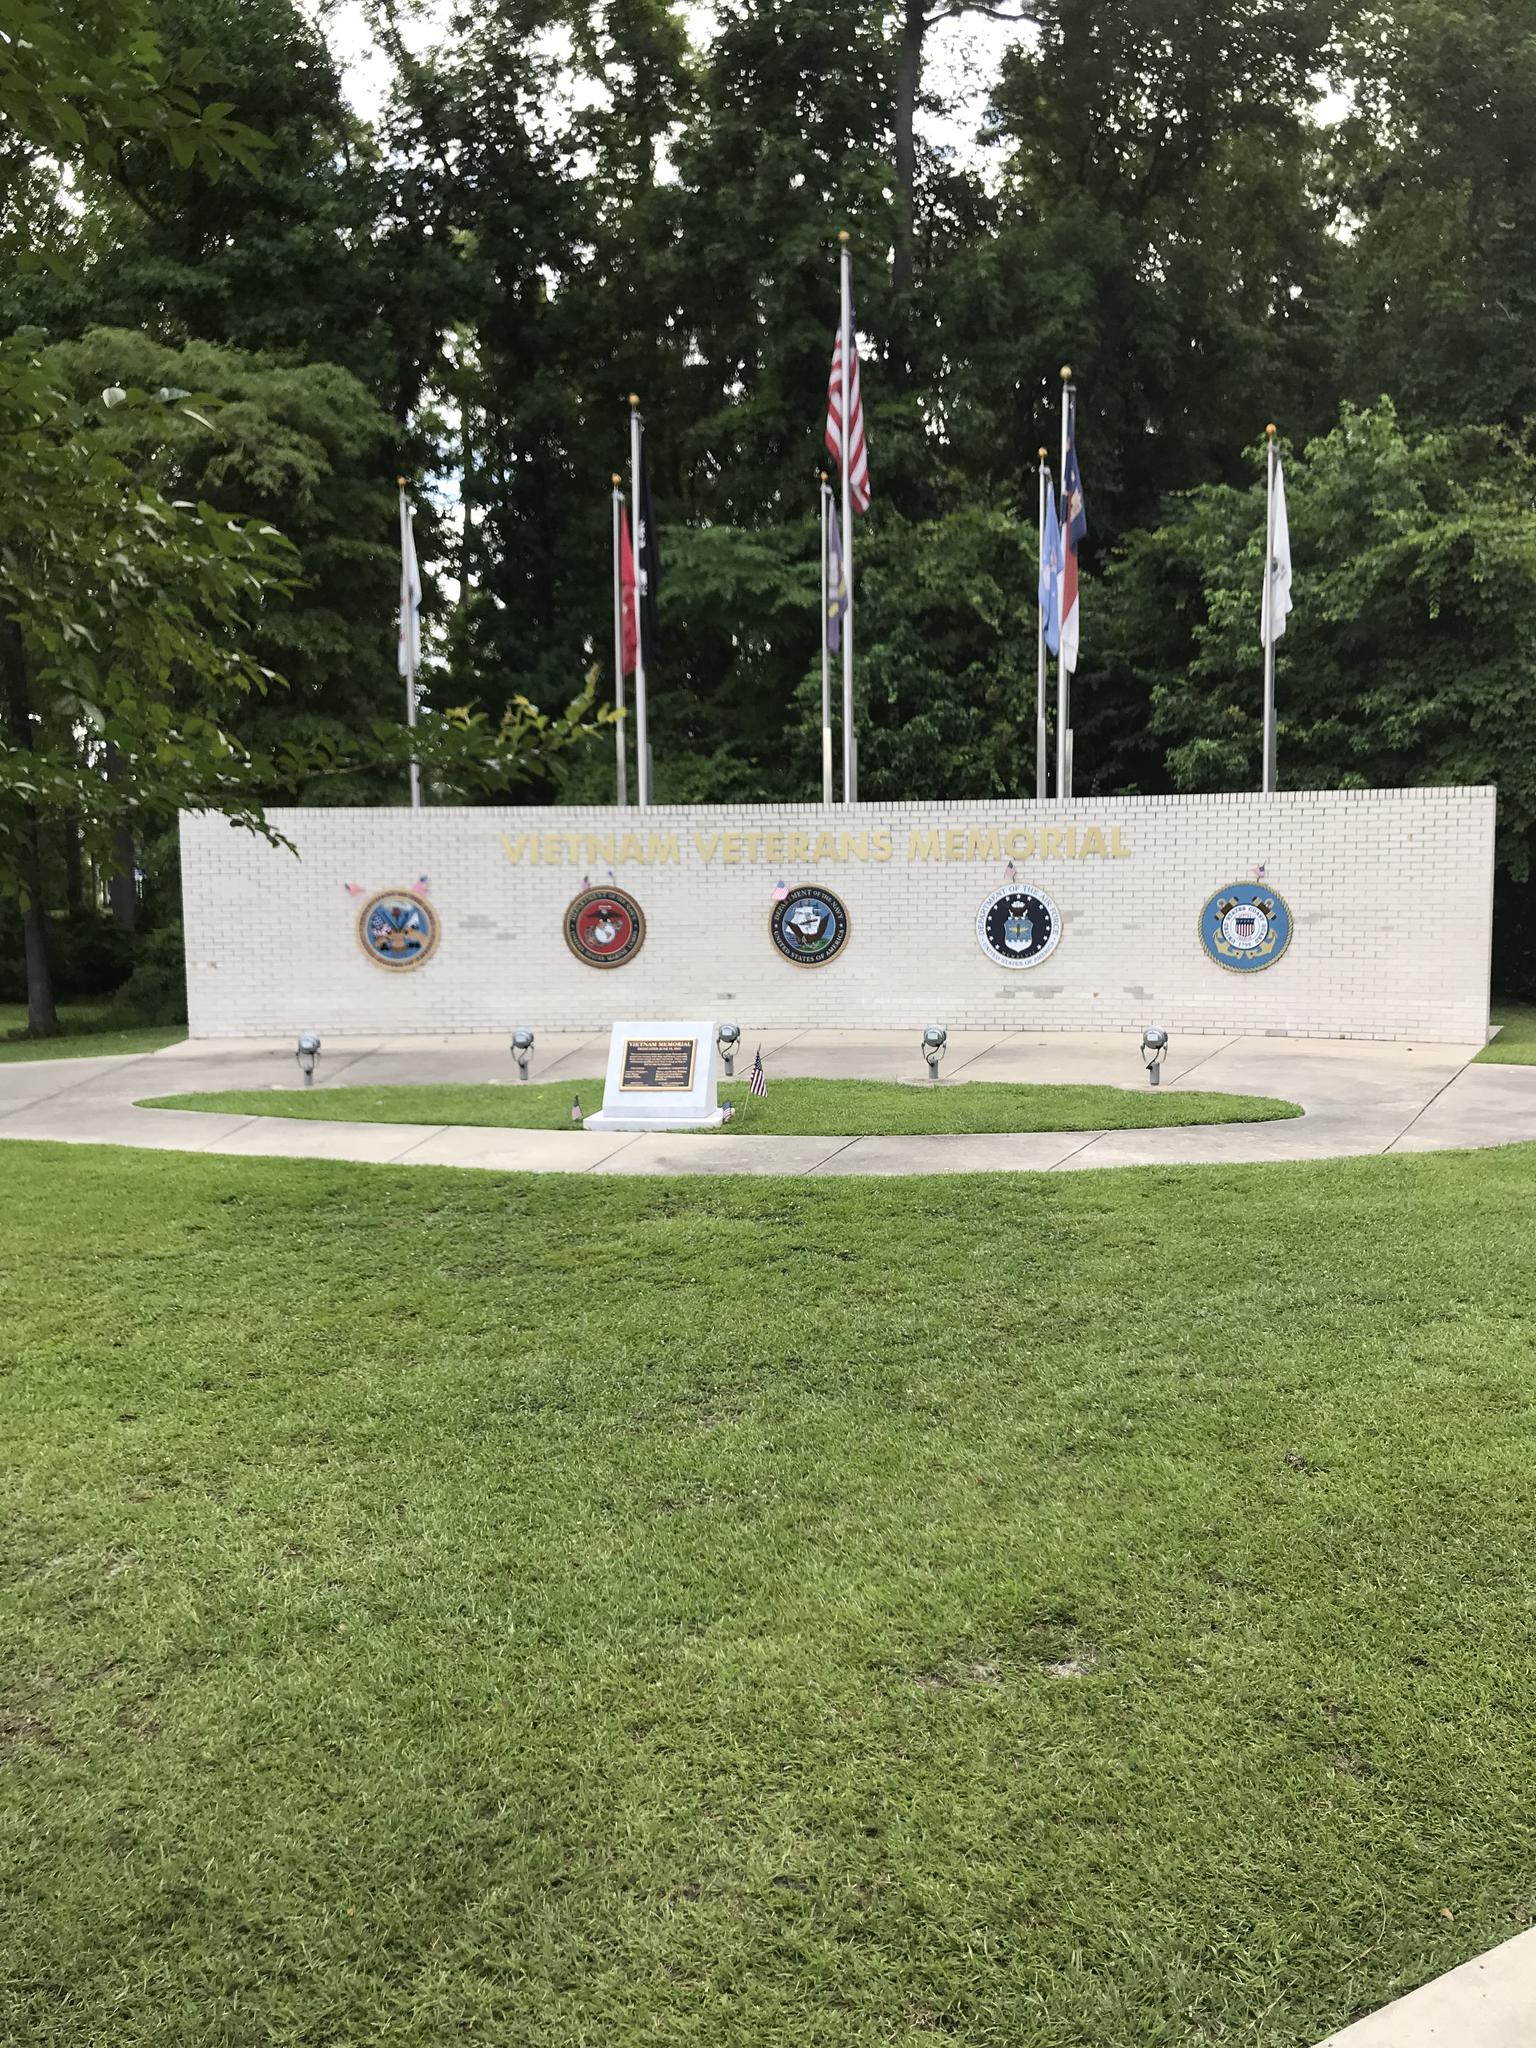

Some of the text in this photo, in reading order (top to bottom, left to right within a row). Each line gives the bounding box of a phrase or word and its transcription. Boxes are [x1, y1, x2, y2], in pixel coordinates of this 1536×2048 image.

[500, 825, 1133, 867] VIETNAM VETERANS MEMORIAL
[830, 900, 844, 919] NAVY
[978, 888, 1007, 935] DEPARTMENT
[1023, 885, 1038, 895] THE
[1050, 907, 1060, 935] FORCE
[773, 931, 791, 954] UNITED
[791, 952, 815, 962] STATES
[825, 929, 845, 956] AMERICA
